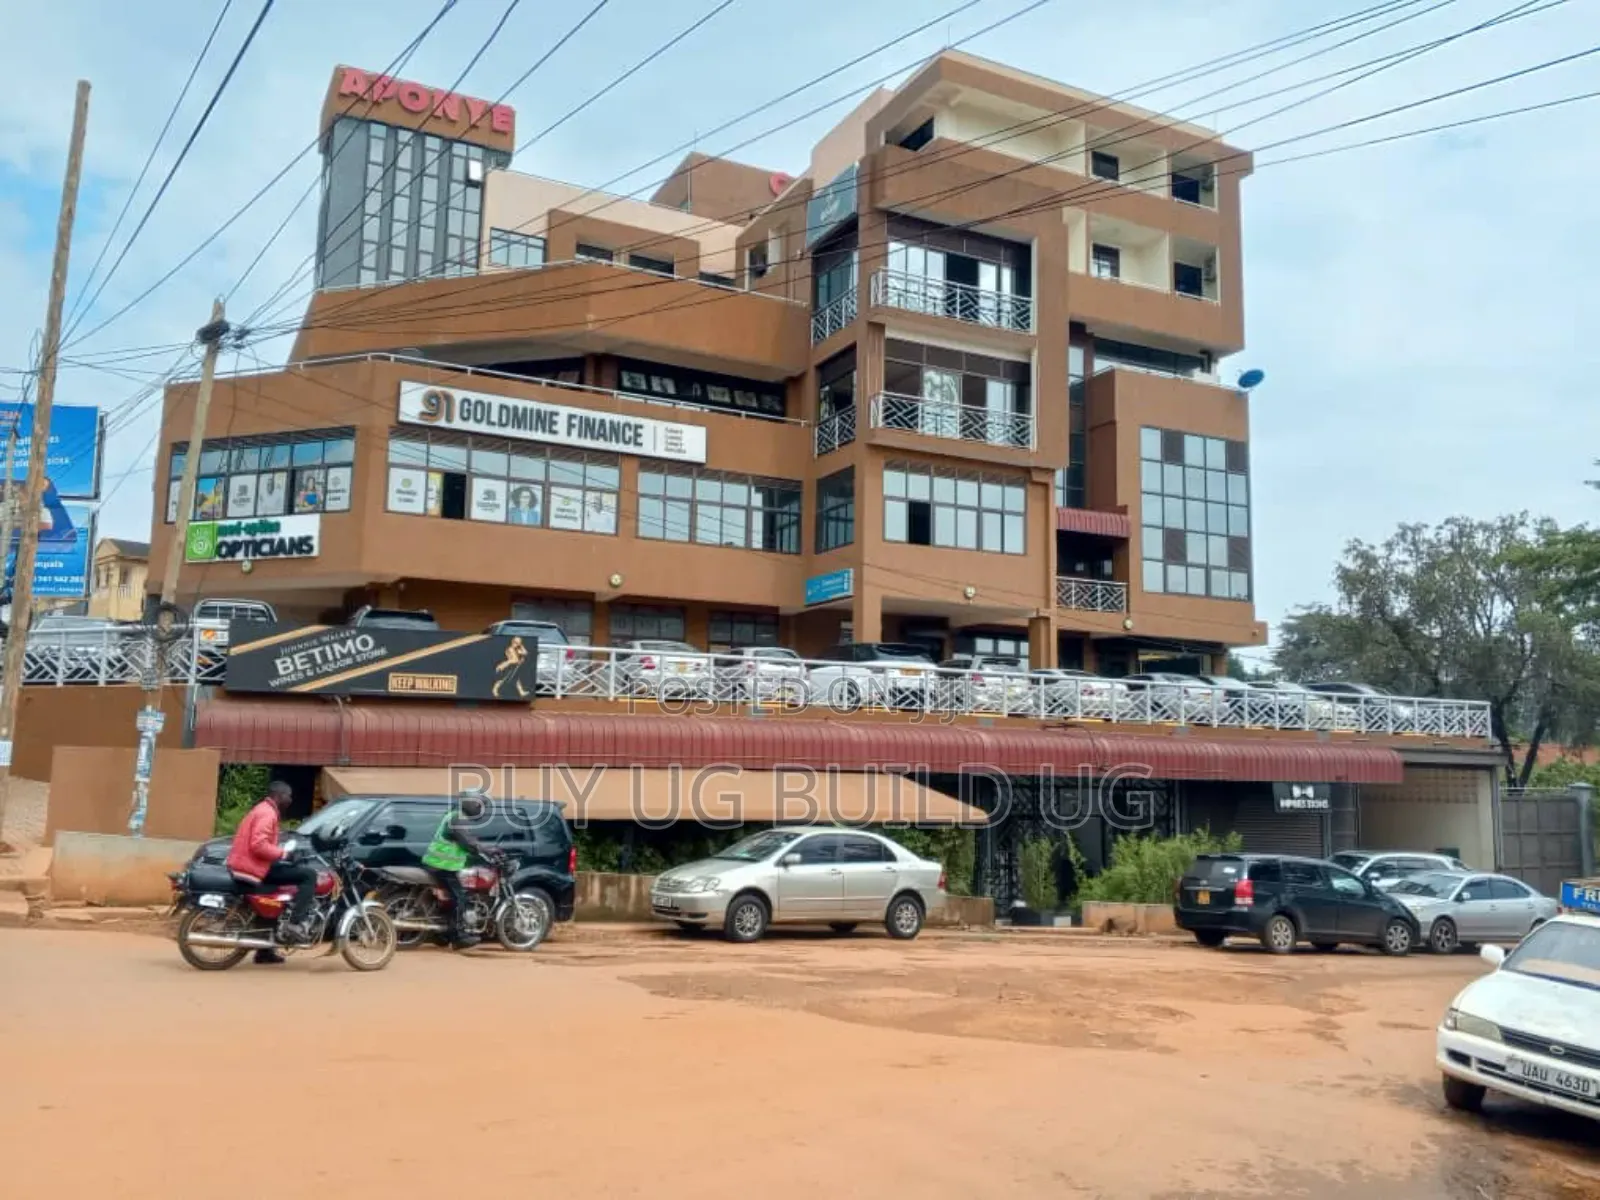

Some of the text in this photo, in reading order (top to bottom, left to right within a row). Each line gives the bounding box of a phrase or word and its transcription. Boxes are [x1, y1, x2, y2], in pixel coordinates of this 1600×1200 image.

[338, 67, 516, 135] APONYE
[459, 397, 559, 436] GOLDMINE
[566, 412, 644, 448] FINANCE
[216, 535, 314, 558] OPTICIANS
[274, 633, 375, 676] BETIMO
[1522, 1061, 1590, 1093] UAU 463D
